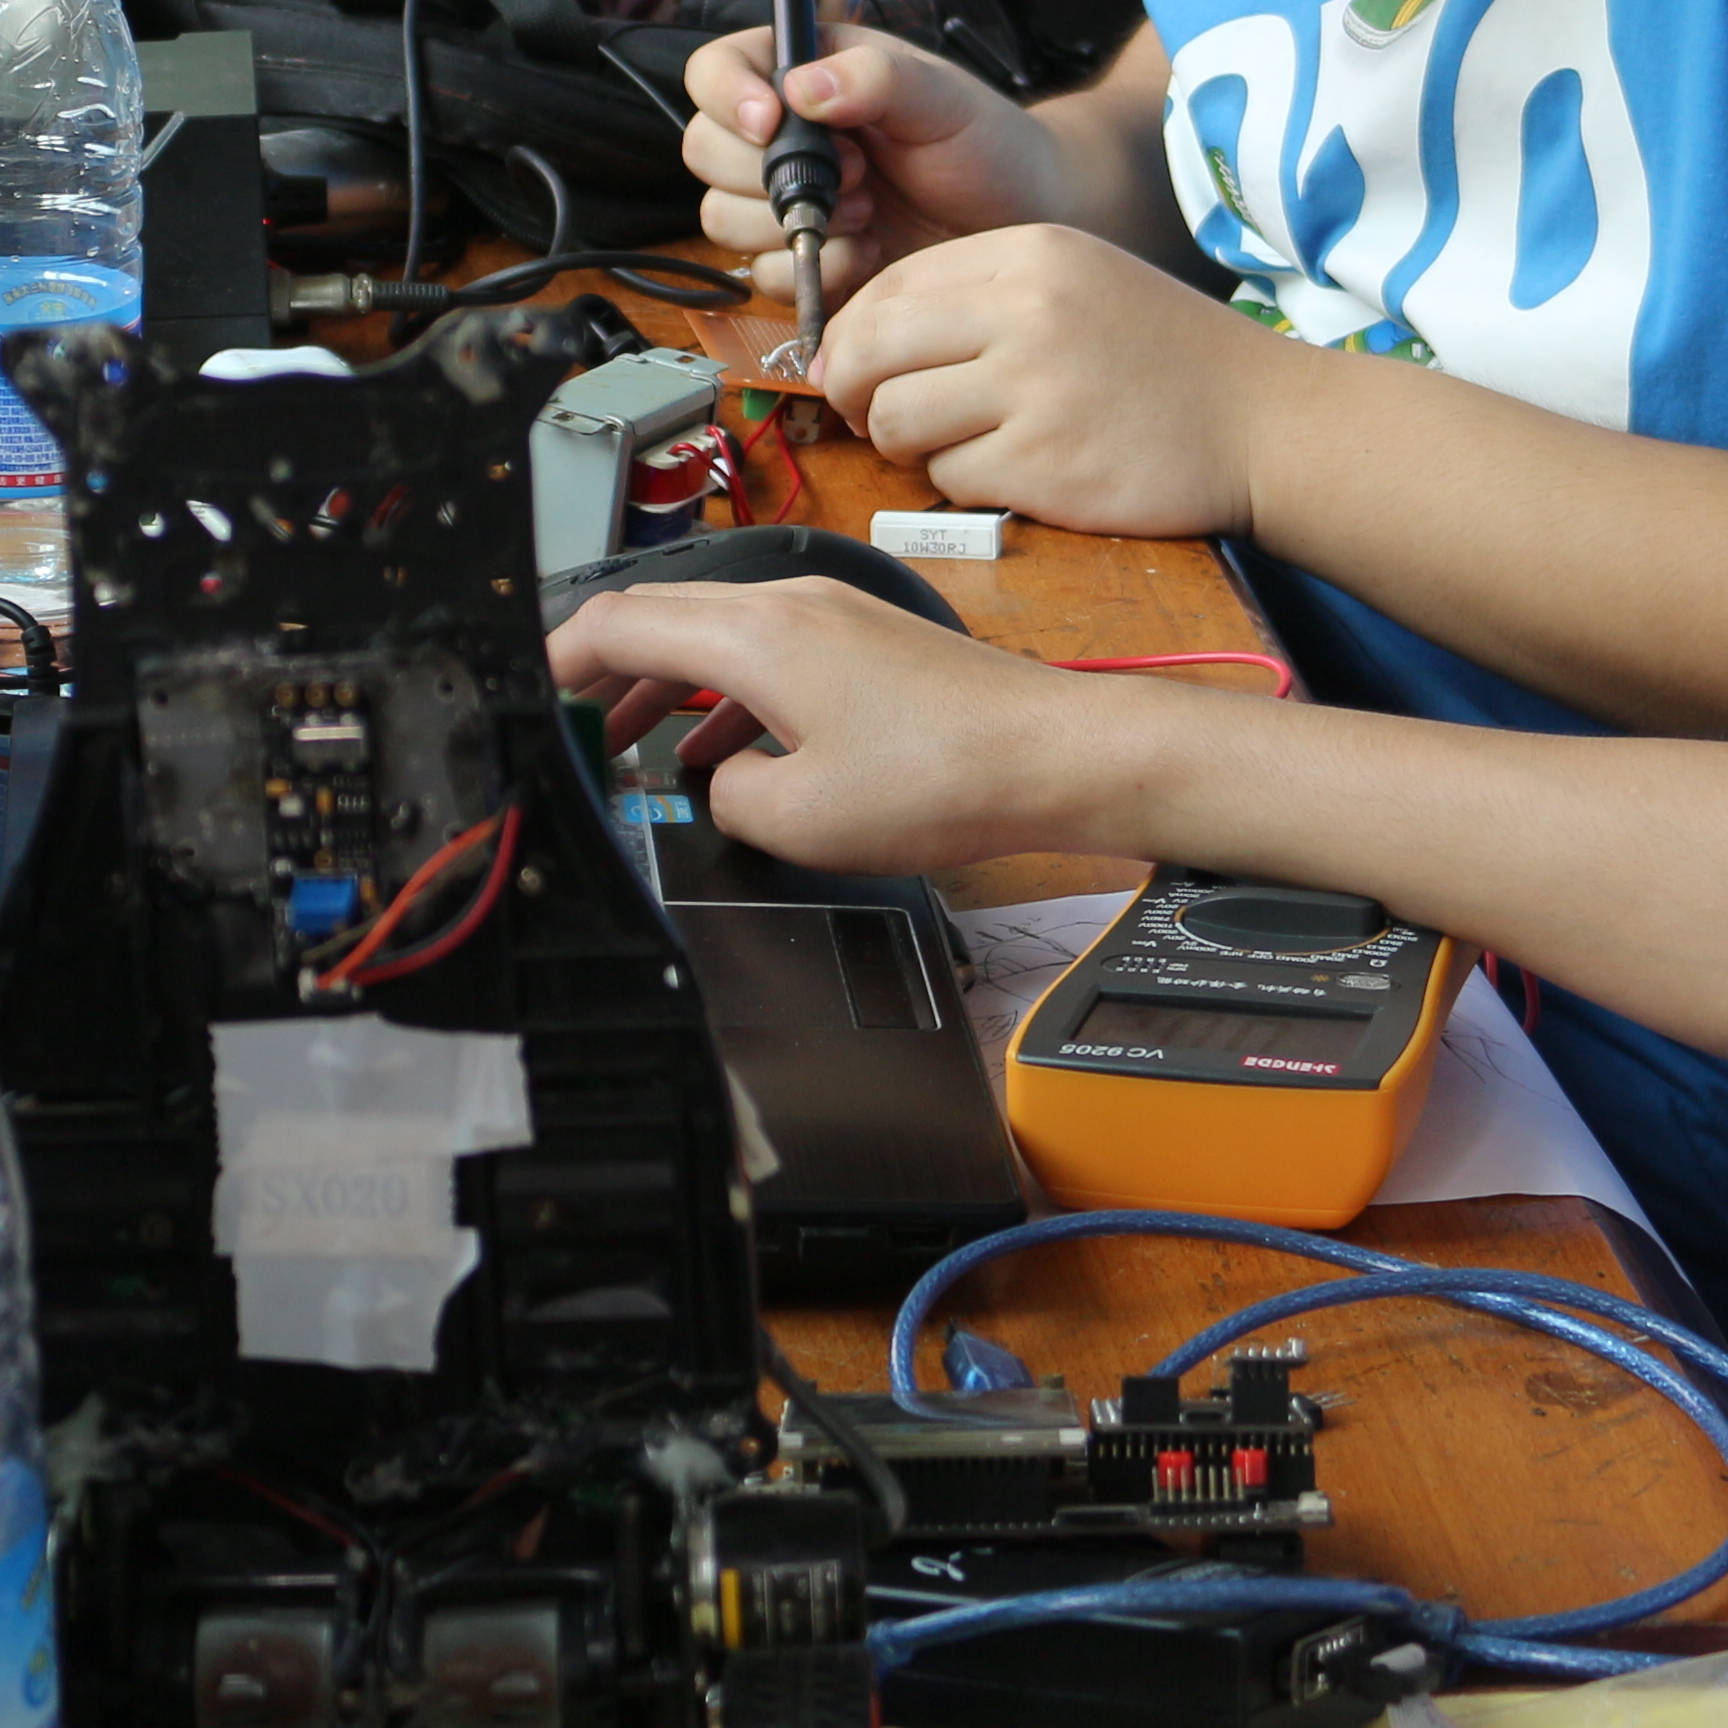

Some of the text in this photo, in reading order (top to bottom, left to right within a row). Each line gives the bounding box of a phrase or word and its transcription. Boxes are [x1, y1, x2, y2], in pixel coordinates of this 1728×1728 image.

[920, 529, 947, 540] SYT
[904, 542, 966, 555] 10W30RJ
[1059, 1043, 1165, 1061] VC 9205
